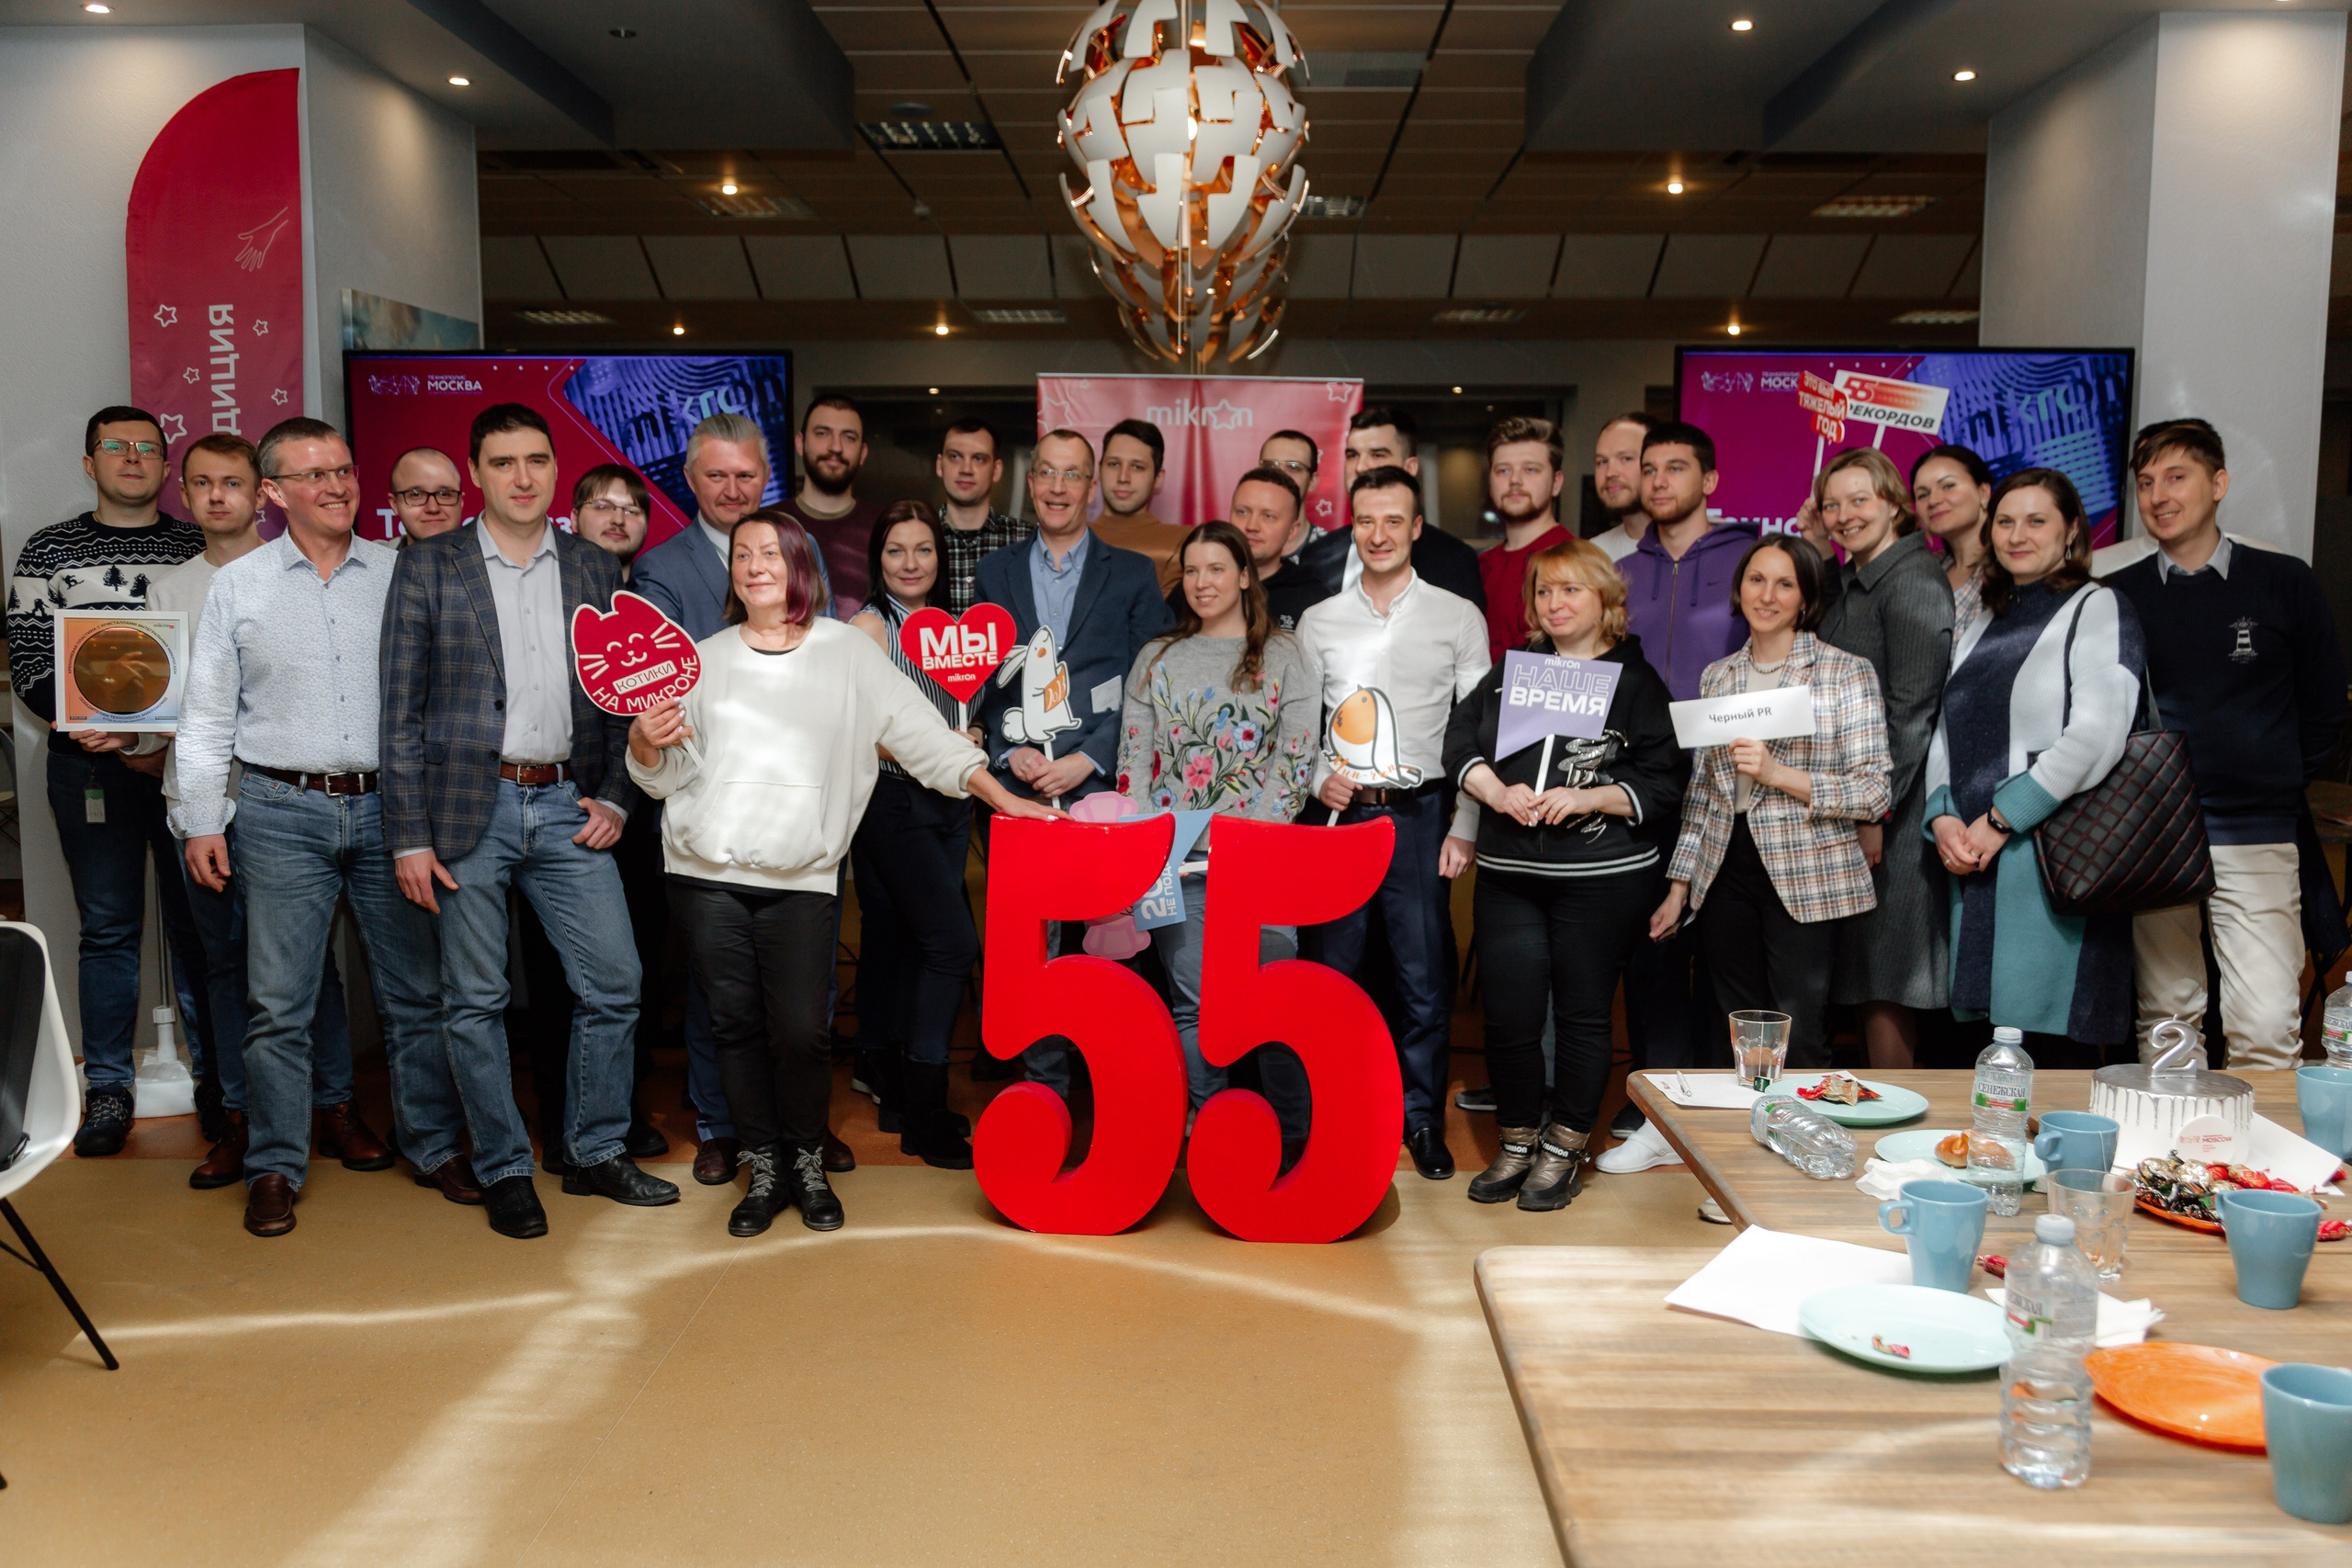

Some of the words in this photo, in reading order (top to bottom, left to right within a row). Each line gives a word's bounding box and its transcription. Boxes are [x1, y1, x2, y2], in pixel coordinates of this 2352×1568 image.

[209, 304, 241, 435] ДИЦИЯ
[1760, 378, 1799, 389] МОСК
[427, 380, 482, 390] МОСКВА
[1816, 414, 1838, 446] ГОД
[920, 622, 998, 657] МЫ
[922, 651, 999, 671] ВМЕСТЕ
[1544, 657, 1581, 670] mikron
[593, 687, 619, 710] НА
[626, 655, 698, 712] МИКРОНЕ
[616, 662, 674, 692] КОТИКИ
[947, 673, 977, 682] mikron
[1512, 664, 1612, 697] НАШЕ
[1509, 685, 1607, 716] ВРЕМЯ
[1709, 708, 1755, 724] Черный
[1758, 706, 1772, 716] PR
[1161, 862, 1174, 896] ПОД
[1166, 897, 1178, 916] НЕ
[973, 812, 1405, 1244] 55
[2150, 1020, 2198, 1078] 2
[1978, 1082, 2026, 1097] СЕНЕЖСКАЯ
